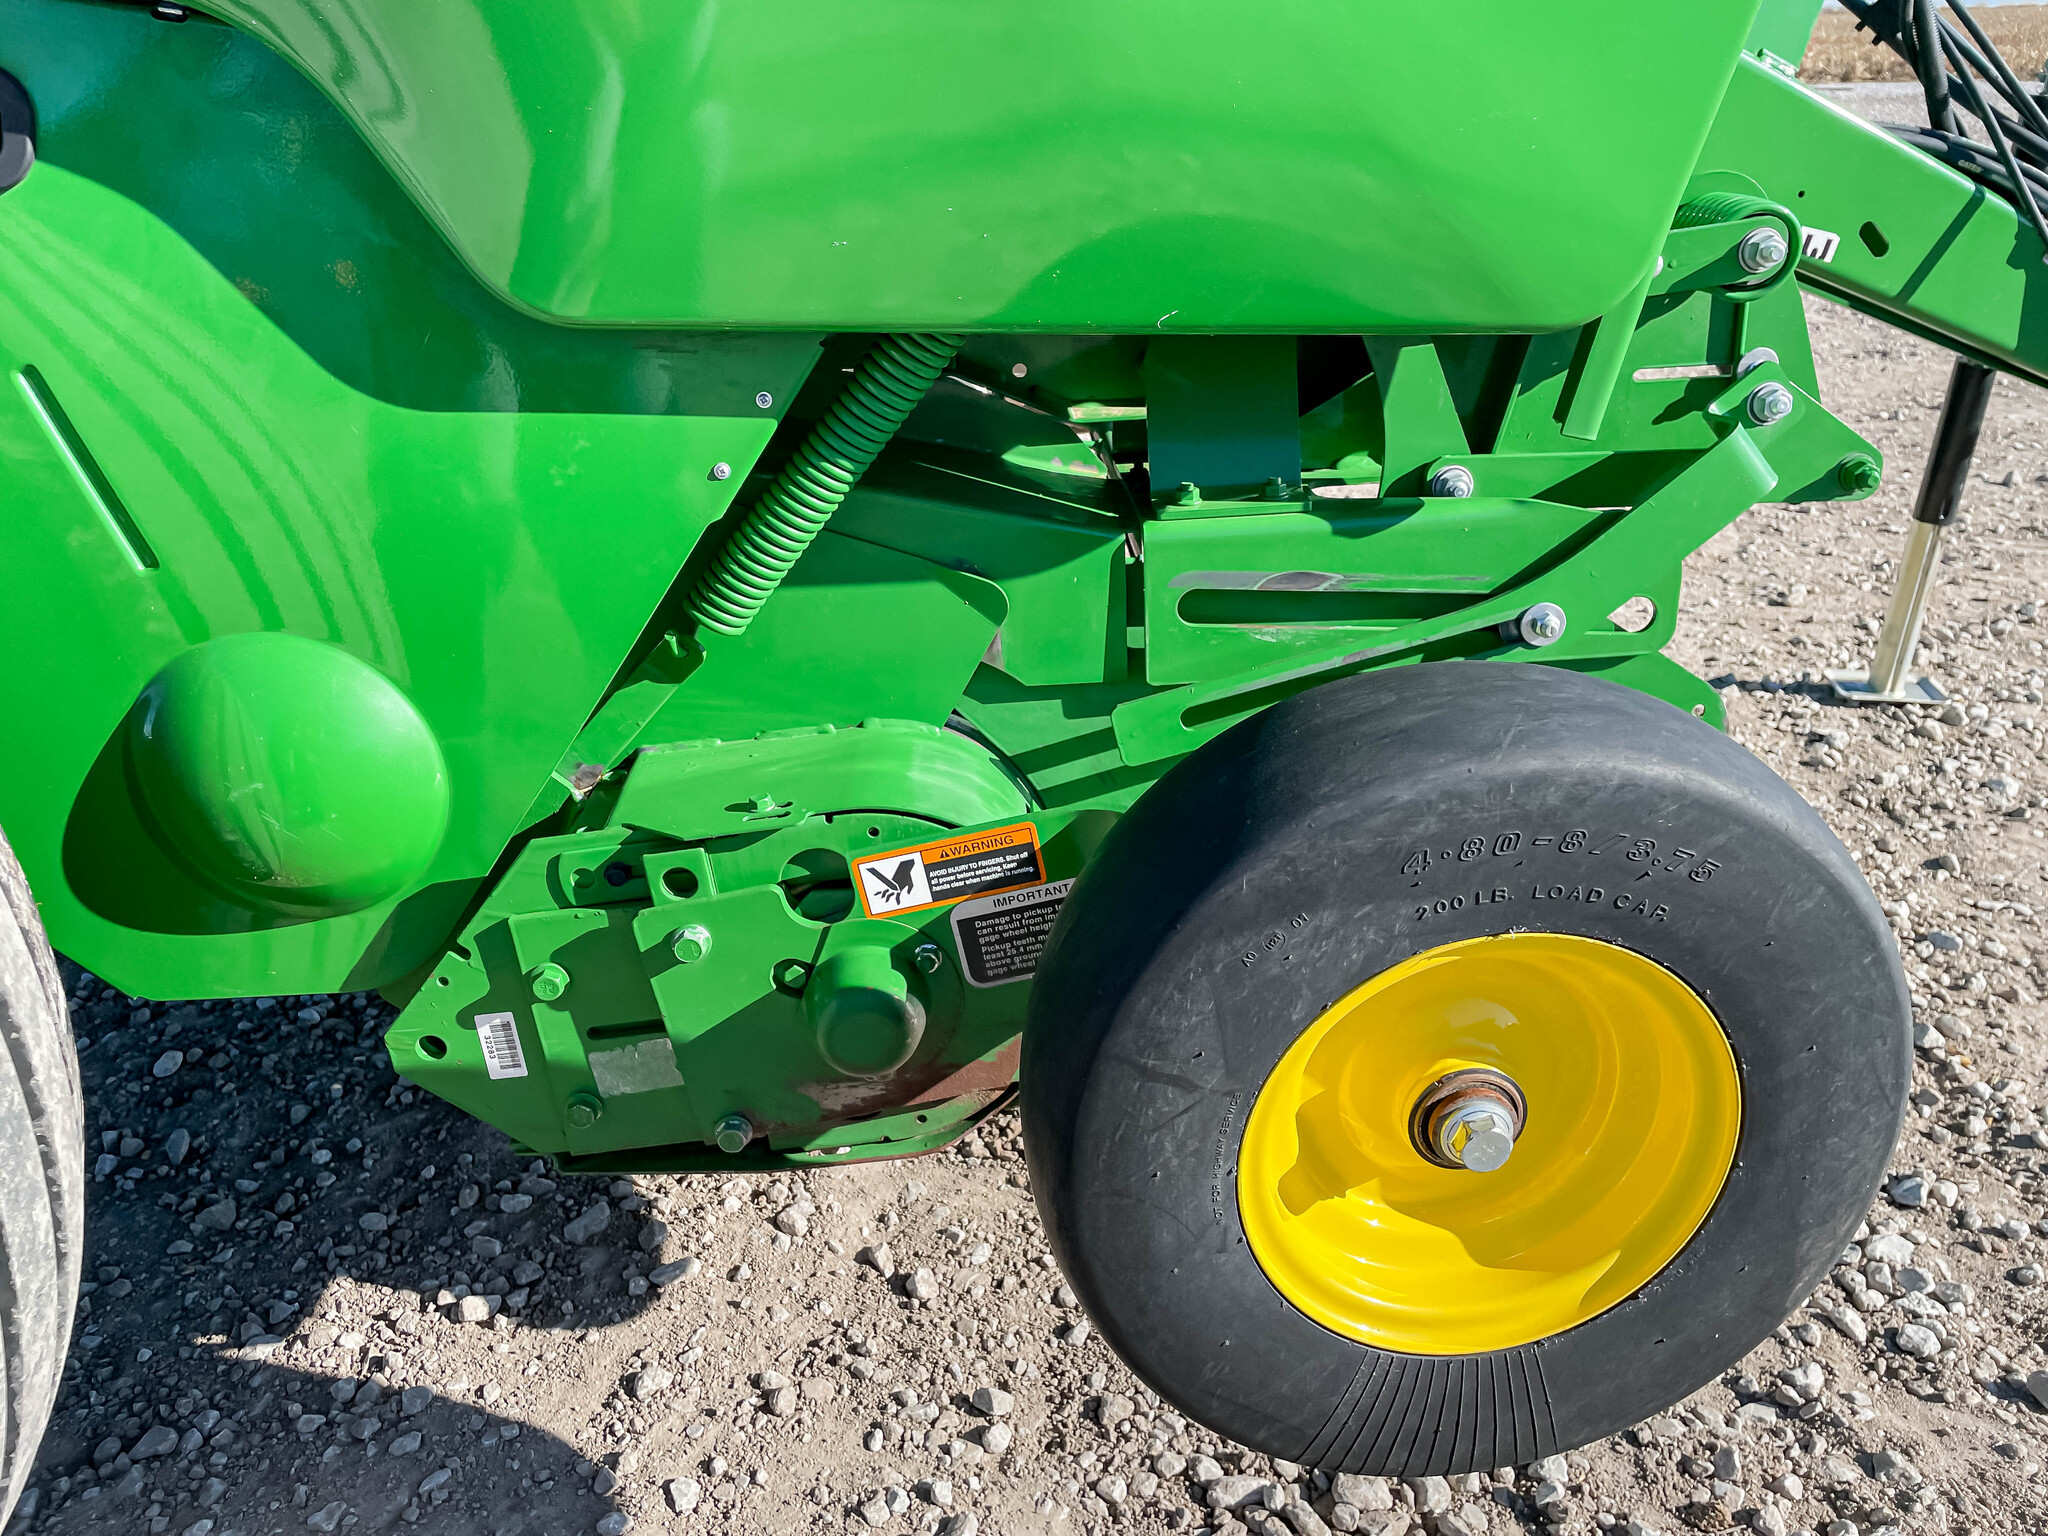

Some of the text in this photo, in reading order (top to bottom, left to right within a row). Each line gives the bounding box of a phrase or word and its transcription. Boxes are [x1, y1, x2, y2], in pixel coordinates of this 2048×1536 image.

[950, 835, 1014, 855] WARNING
[929, 868, 947, 878] AVOID
[947, 863, 970, 874] INJURY
[977, 856, 1005, 867] FINGERS.
[1005, 853, 1019, 861] Shut
[938, 875, 956, 884] power
[956, 870, 974, 879] before
[975, 864, 1002, 876] servicing.
[1002, 861, 1017, 869] Keep
[932, 883, 950, 892] hands
[950, 880, 964, 888] clear
[964, 876, 980, 884] when
[980, 871, 1004, 881] machine
[1011, 865, 1034, 876] running.
[993, 884, 1069, 908] IMPORTANT
[1416, 896, 1465, 921] 200
[1475, 887, 1515, 906] LB.
[1532, 884, 1605, 903] LOAD
[975, 915, 1010, 928] Damage
[1023, 904, 1053, 917] pickup
[976, 927, 992, 935] can
[994, 920, 1020, 931] result
[1022, 915, 1042, 925] from
[978, 933, 1000, 944] gage
[1002, 926, 1027, 938] wheel
[982, 941, 1011, 953] Pickup
[1013, 935, 1034, 946] teeth
[983, 950, 1004, 960] least
[1006, 946, 1023, 956] 25.4
[984, 957, 1011, 968] above
[987, 959, 1035, 976] gage wheel
[484, 1035, 496, 1060] 32283
[1212, 1092, 1243, 1226] NOT FOR HIGHWAY SERVICE
